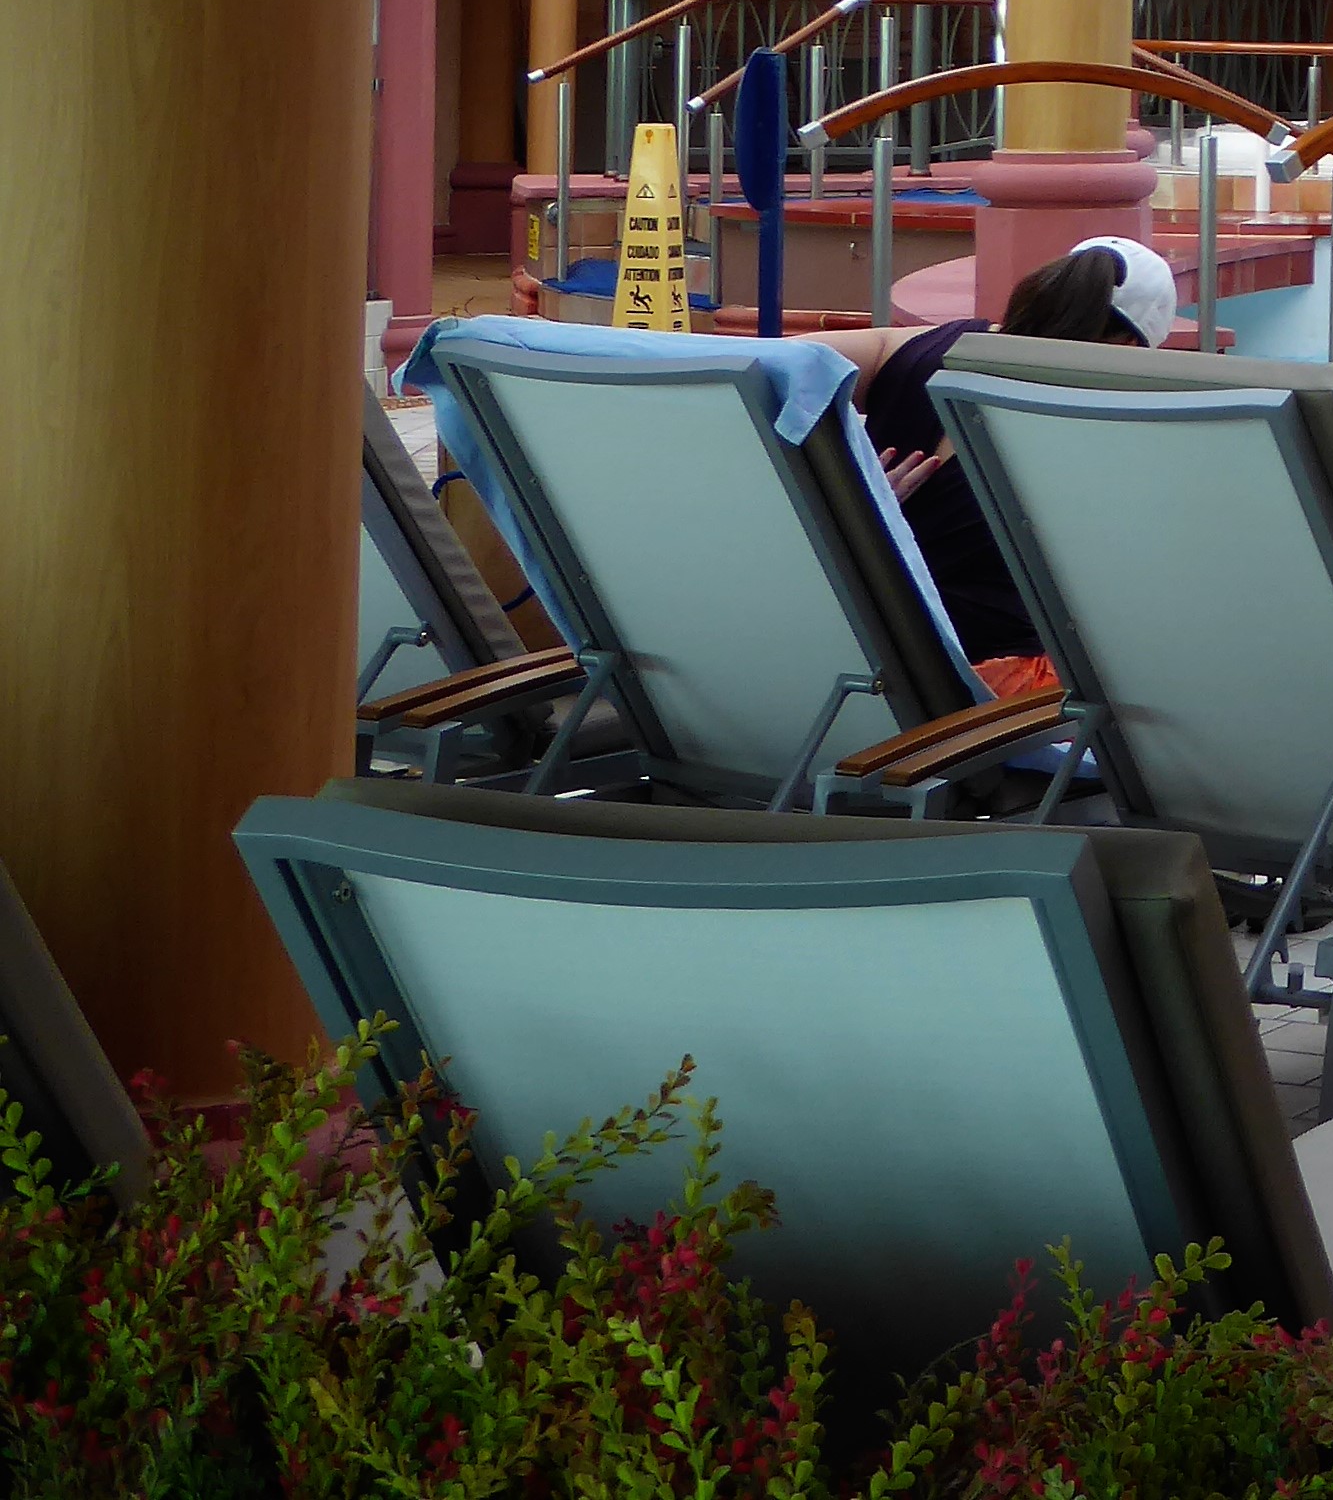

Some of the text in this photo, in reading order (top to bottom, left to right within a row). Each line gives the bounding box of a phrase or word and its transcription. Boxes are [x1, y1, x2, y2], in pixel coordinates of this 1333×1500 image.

[629, 217, 659, 231] CAUTION
[627, 245, 660, 259] CUIDADO
[624, 268, 660, 281] ATTENTION
